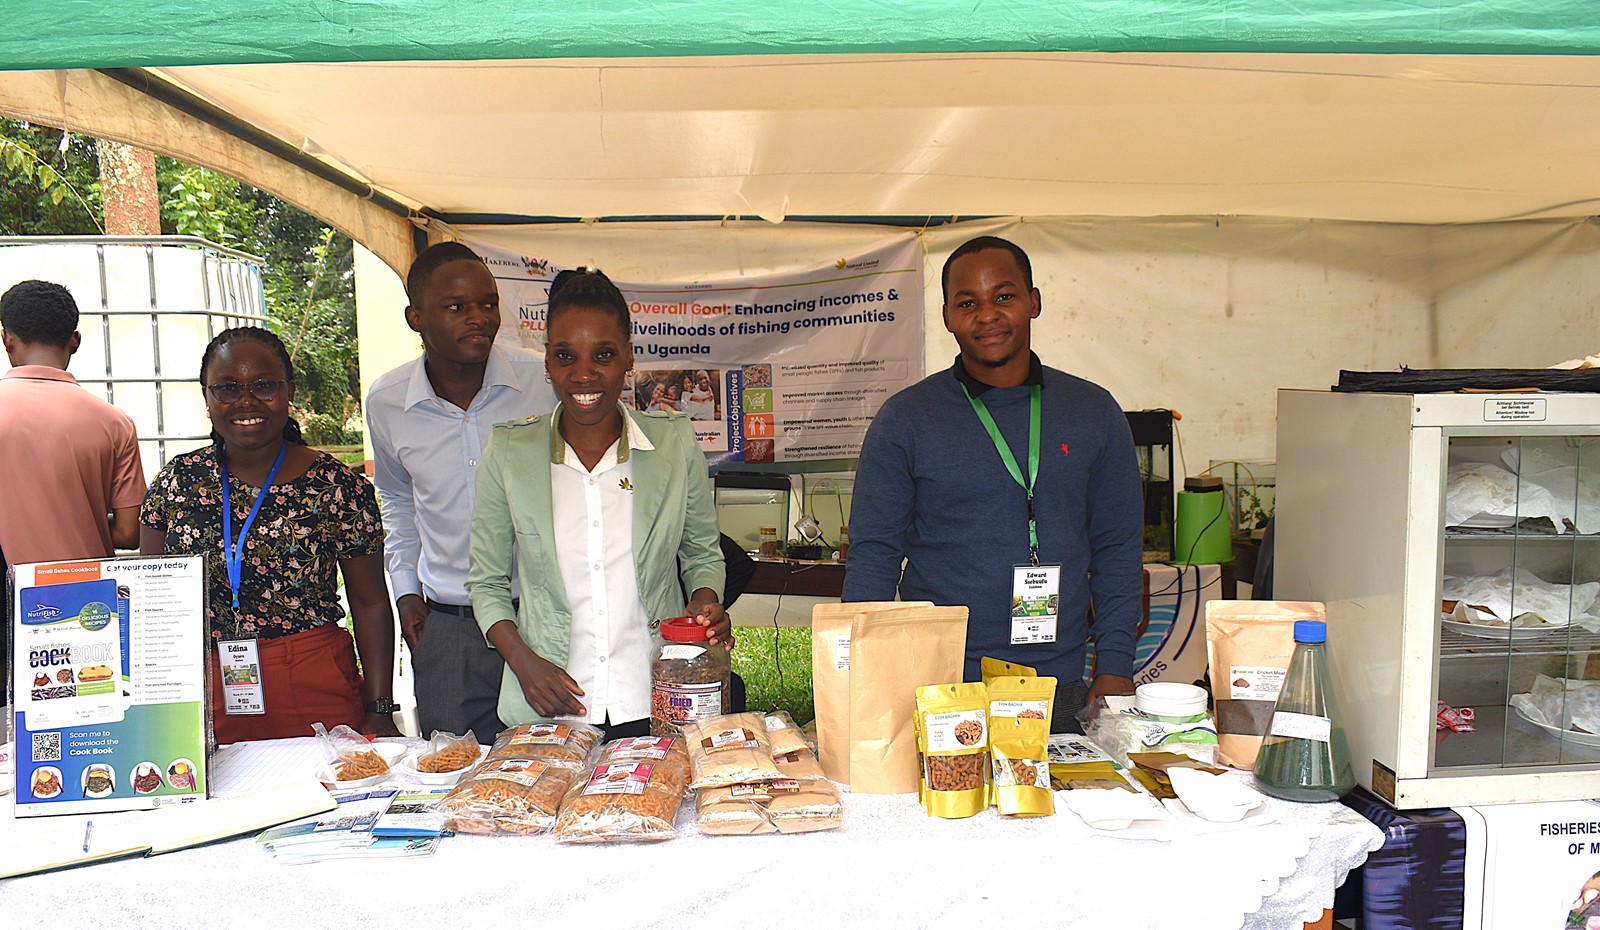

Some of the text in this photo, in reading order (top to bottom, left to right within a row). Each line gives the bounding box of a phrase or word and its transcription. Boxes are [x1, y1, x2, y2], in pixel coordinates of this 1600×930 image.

[630, 288, 899, 316] Overall Goal: Enhancing incomes &
[719, 323, 735, 335] of
[738, 319, 790, 336] fishing
[793, 310, 895, 331] communities
[647, 343, 710, 358] Uganda
[730, 373, 740, 421] Objectives
[70, 565, 98, 573] Cookbook
[122, 564, 141, 573] your
[142, 563, 162, 571] copy
[164, 561, 188, 570] today
[27, 609, 57, 619] NutriFish
[228, 645, 248, 653] Edina
[670, 697, 692, 707] FRIED
[69, 739, 107, 747] download
[69, 747, 113, 756] Cook Book
[1568, 842, 1585, 855] OF
